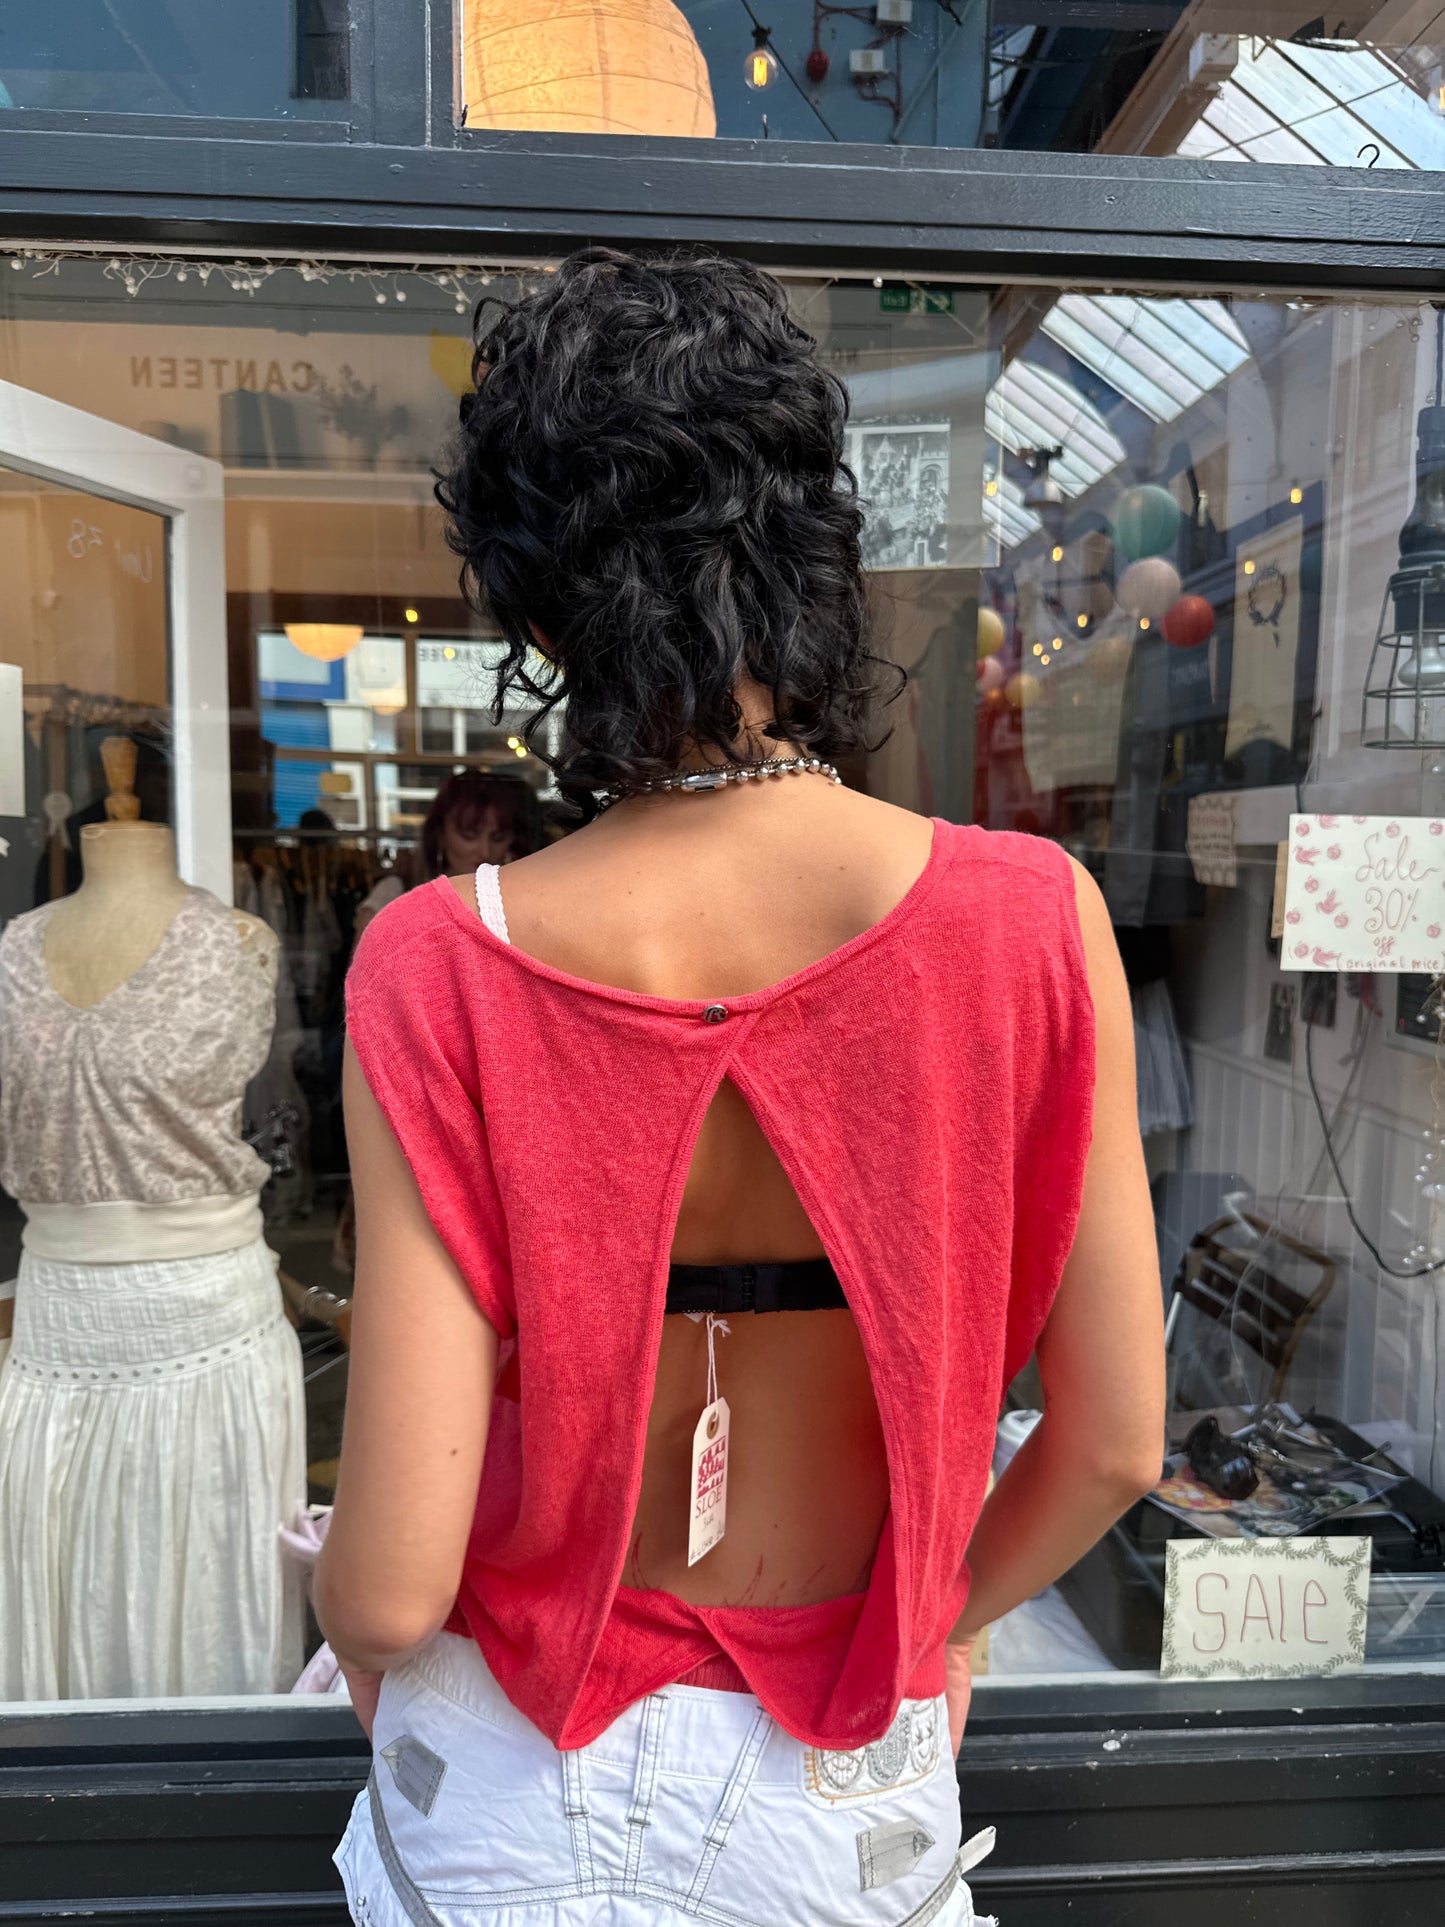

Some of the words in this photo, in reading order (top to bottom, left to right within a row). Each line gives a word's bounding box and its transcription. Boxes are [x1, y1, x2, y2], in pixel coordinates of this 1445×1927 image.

[1355, 831, 1440, 882] Sale
[1364, 887, 1419, 934] 30%
[1373, 935, 1395, 957] off
